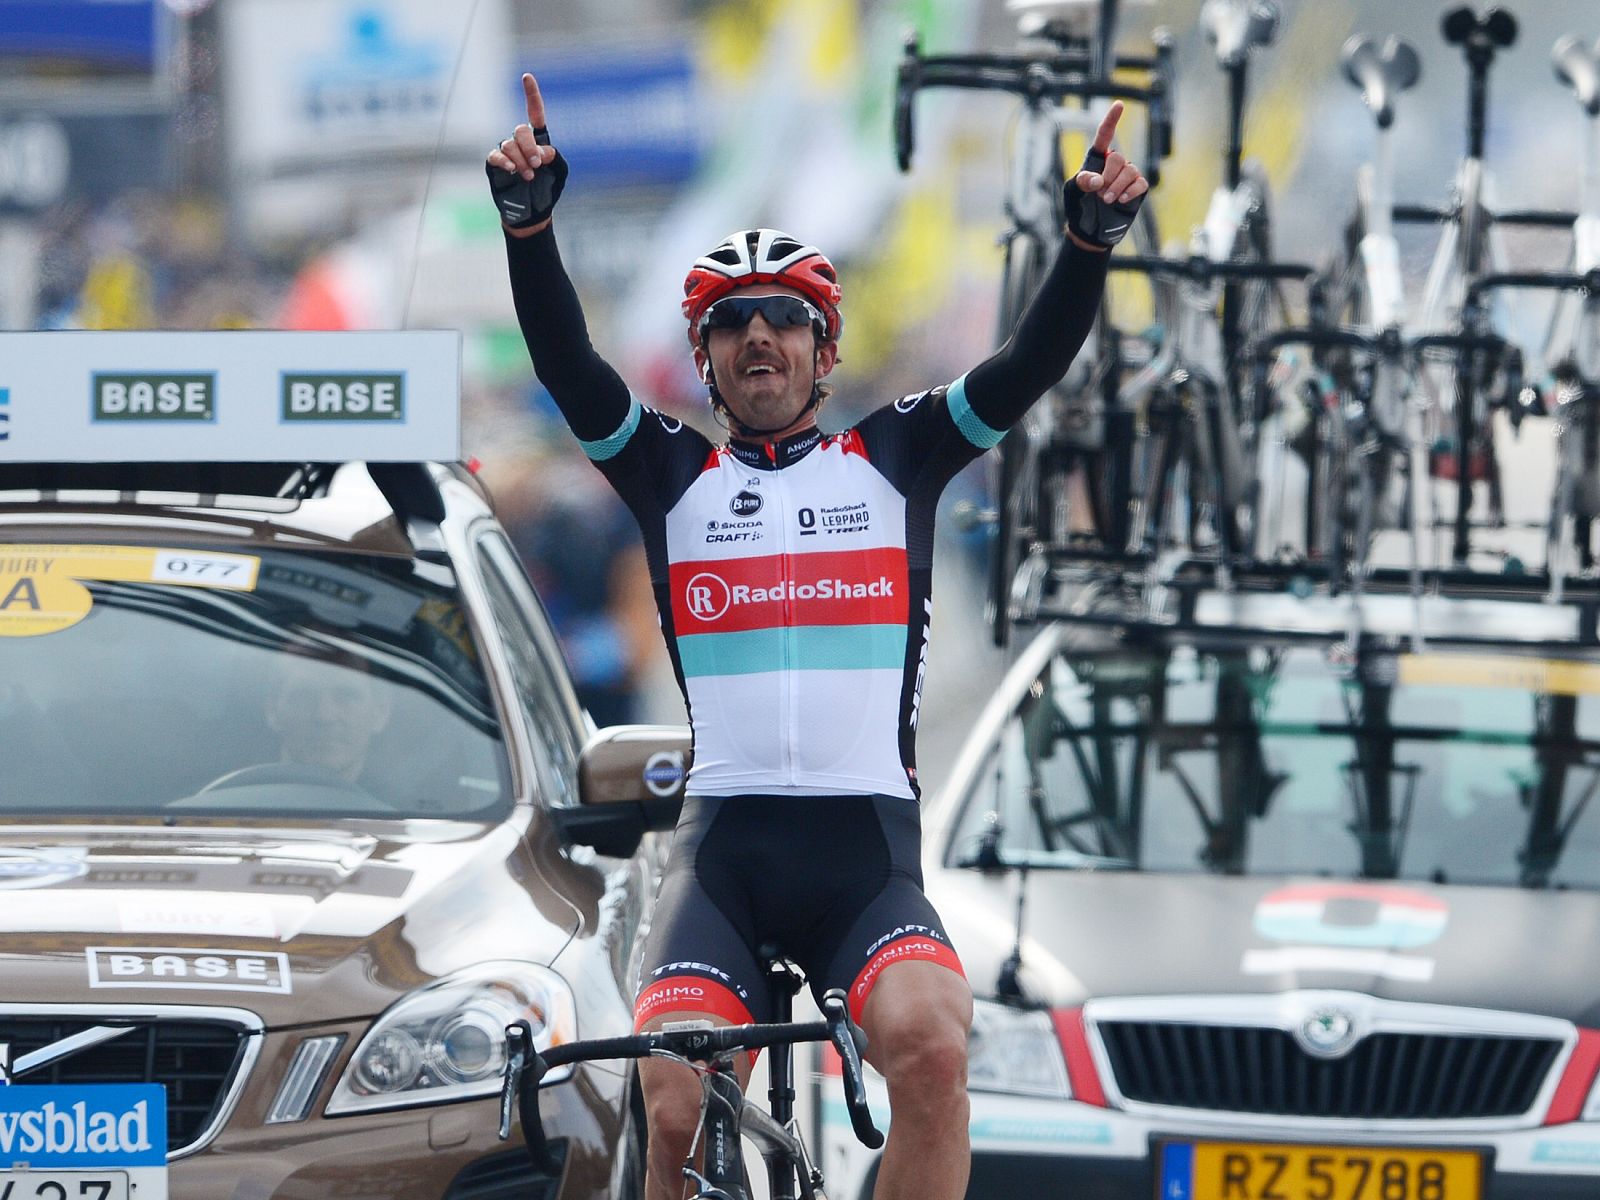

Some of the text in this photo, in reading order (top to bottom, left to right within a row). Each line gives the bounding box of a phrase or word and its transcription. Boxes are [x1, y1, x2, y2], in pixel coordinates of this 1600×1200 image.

[102, 382, 206, 413] BASE
[290, 382, 395, 413] BASE
[820, 502, 867, 514] RadioShack
[821, 510, 870, 527] LEOPARD
[705, 532, 750, 543] CRAFT
[824, 524, 870, 534] TREK
[167, 559, 240, 577] 077
[732, 576, 894, 605] RadioShack
[866, 924, 928, 957] CRAFT
[110, 955, 268, 981] BASE
[650, 961, 731, 981] TREK
[857, 943, 936, 996] ANONIMO
[715, 1119, 725, 1177] TREK
